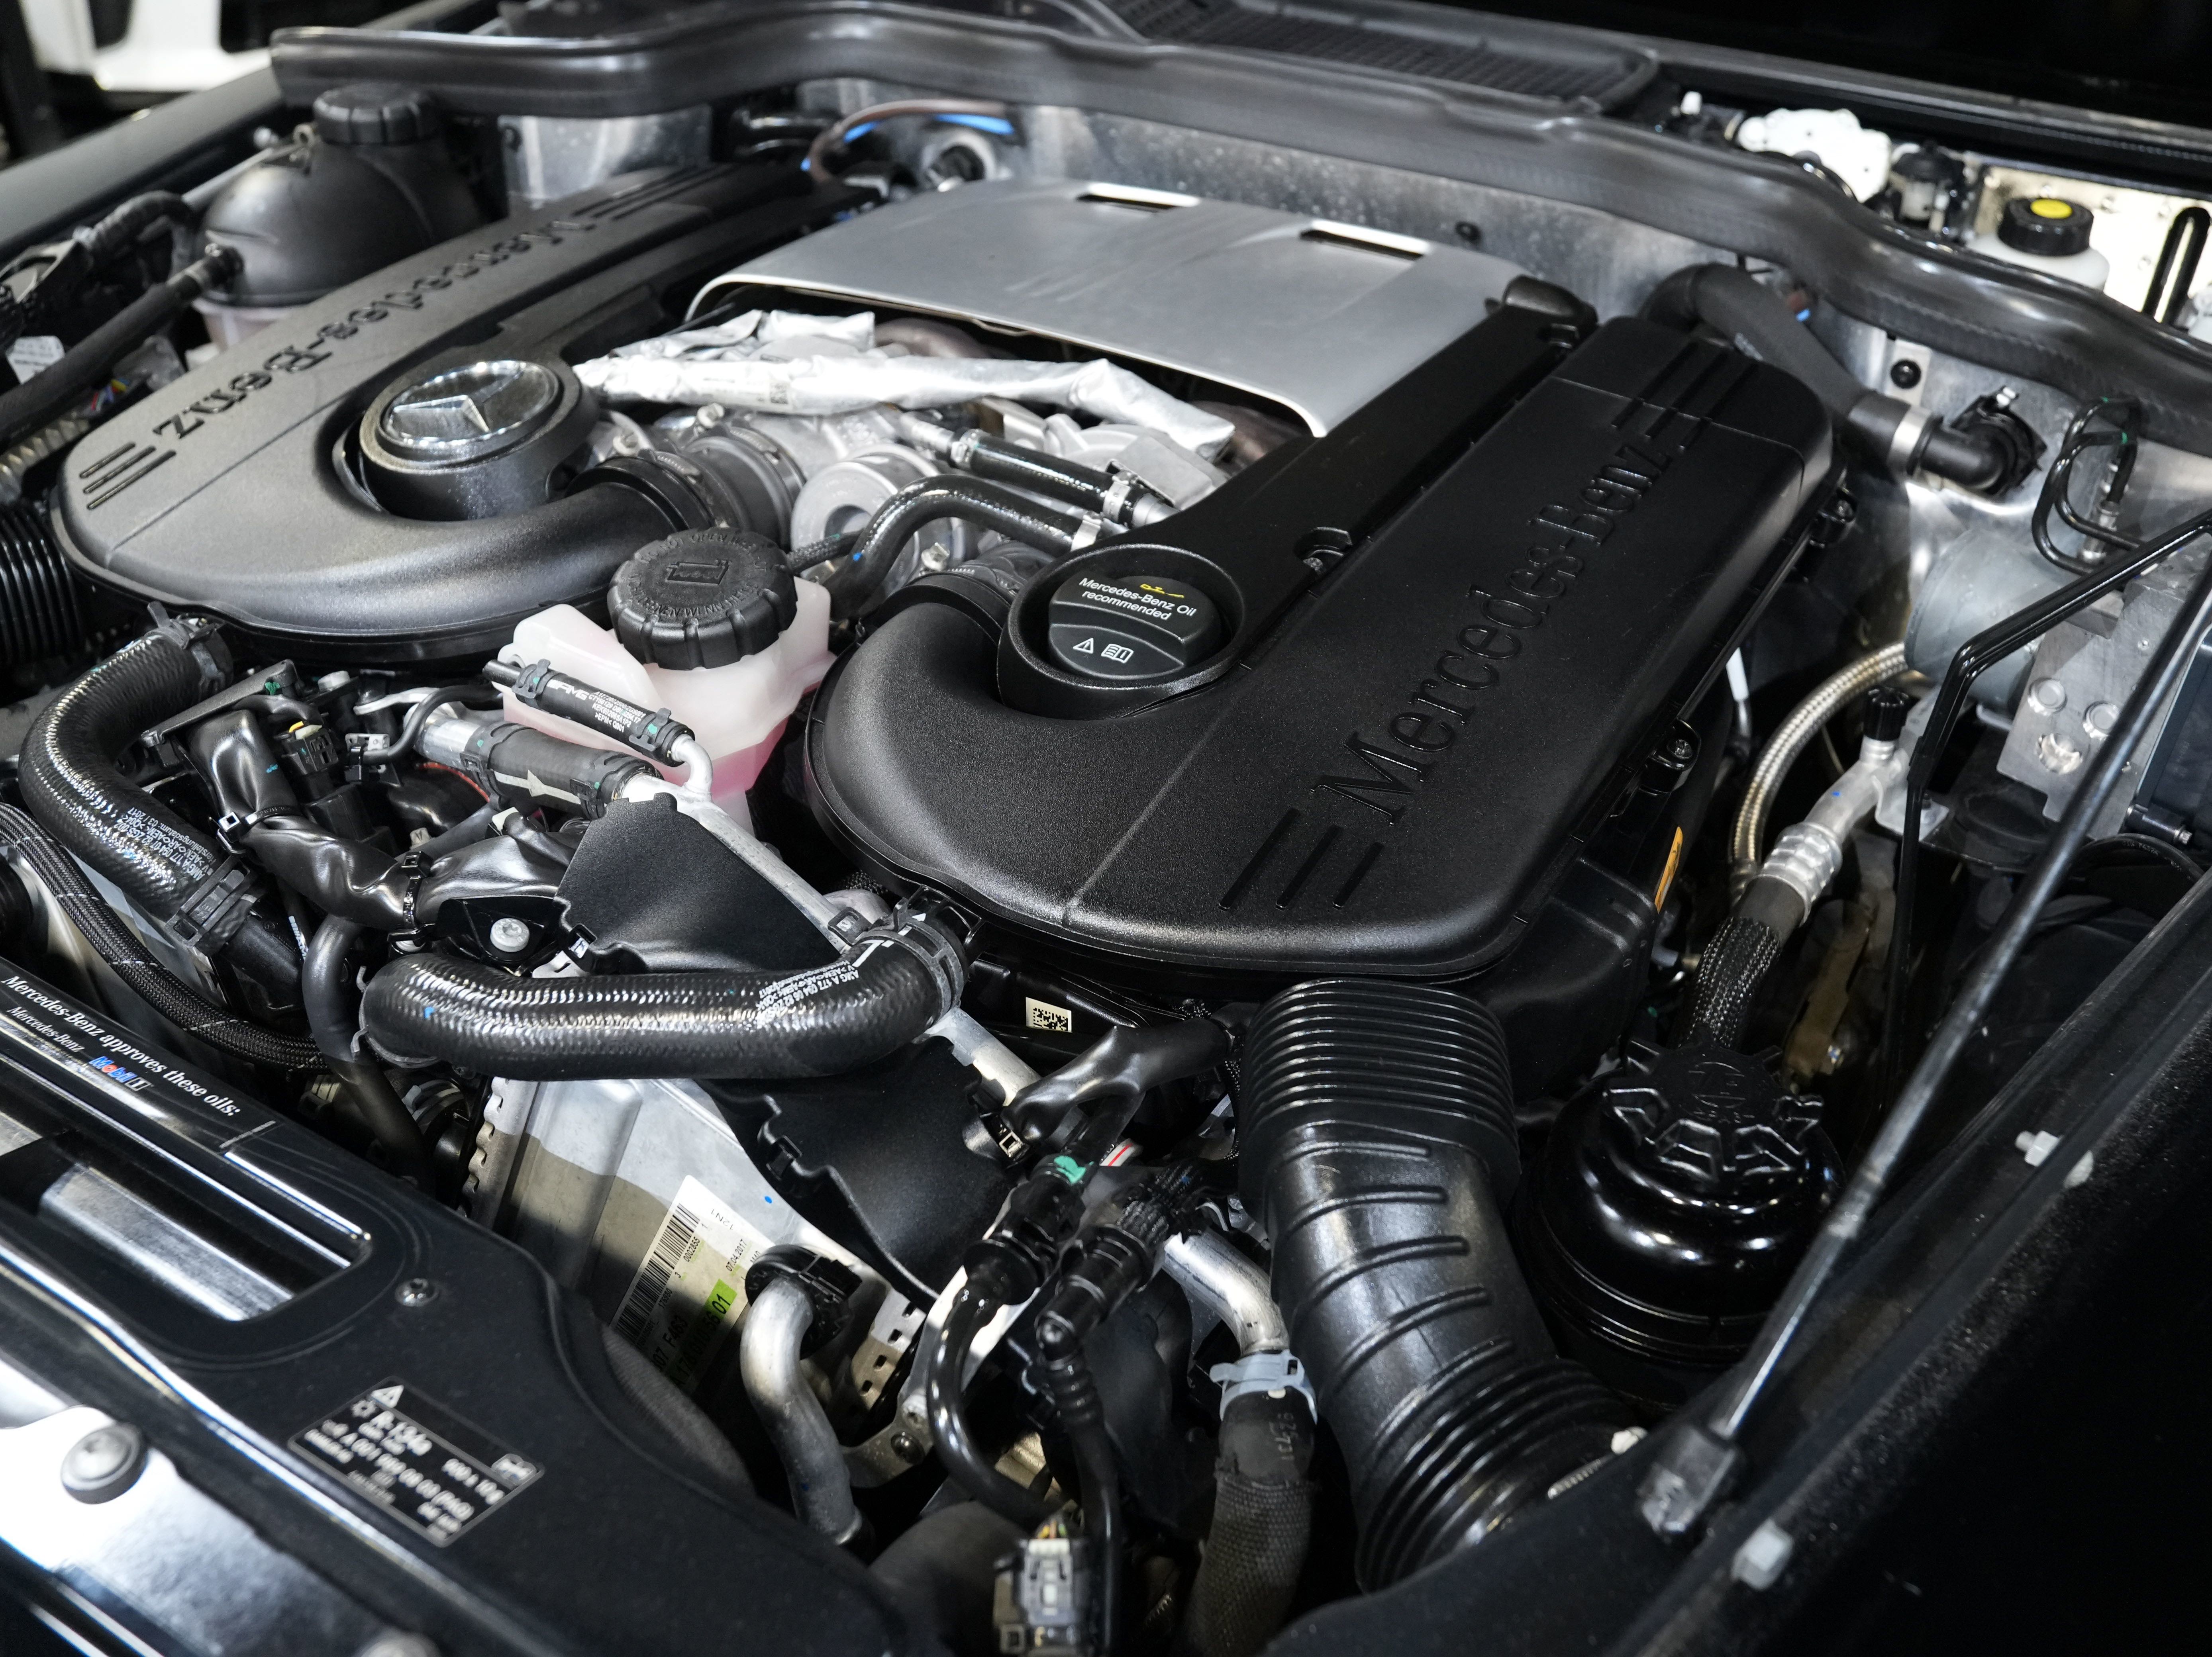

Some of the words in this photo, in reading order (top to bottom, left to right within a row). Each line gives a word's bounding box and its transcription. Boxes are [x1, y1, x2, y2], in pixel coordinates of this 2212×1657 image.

[153, 219, 598, 439] Mercedes-Benz
[1079, 578, 1175, 610] Mercedes-Benz
[1177, 605, 1197, 617] Oil
[1082, 590, 1171, 620] recommended
[1310, 445, 1673, 826] Mercedes-Benz
[127, 807, 146, 820] 2017
[169, 852, 183, 865] 177
[186, 864, 205, 881] AMG
[7, 1007, 85, 1052] Mercedes-Benz
[1, 976, 105, 1036] Mercedes-Benz
[99, 1035, 167, 1073] approves
[163, 1070, 208, 1096] these
[204, 1095, 241, 1116] oils:
[88, 1056, 137, 1083] Mobil
[683, 1236, 700, 1262] 0002855
[726, 1238, 747, 1271] 07.04.2017
[712, 1294, 731, 1314] 01
